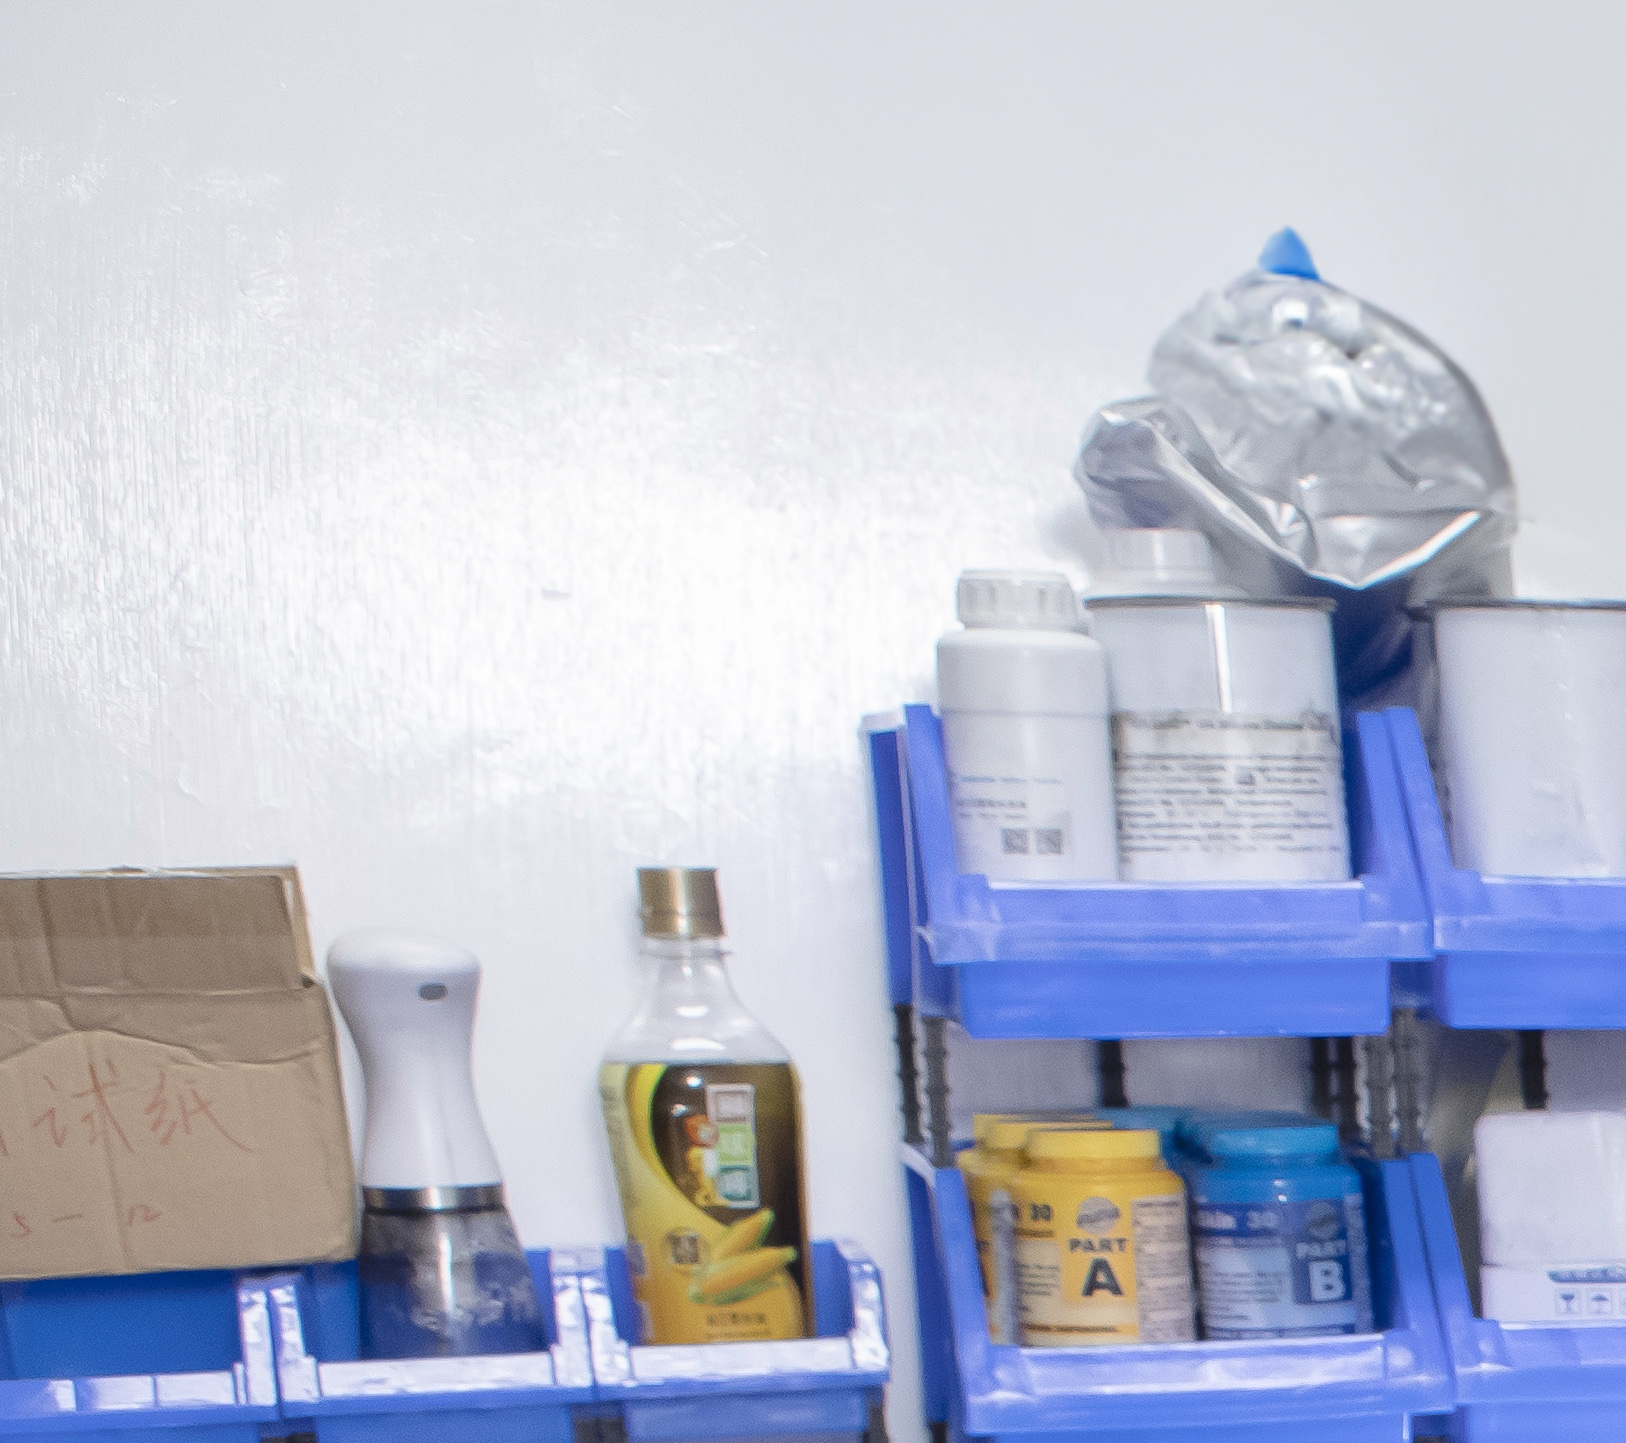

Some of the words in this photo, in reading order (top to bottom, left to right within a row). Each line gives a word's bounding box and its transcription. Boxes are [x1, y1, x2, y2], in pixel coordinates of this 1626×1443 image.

[1068, 1237, 1128, 1253] PART
[1081, 1257, 1125, 1297] A
[1308, 1259, 1345, 1302] B
